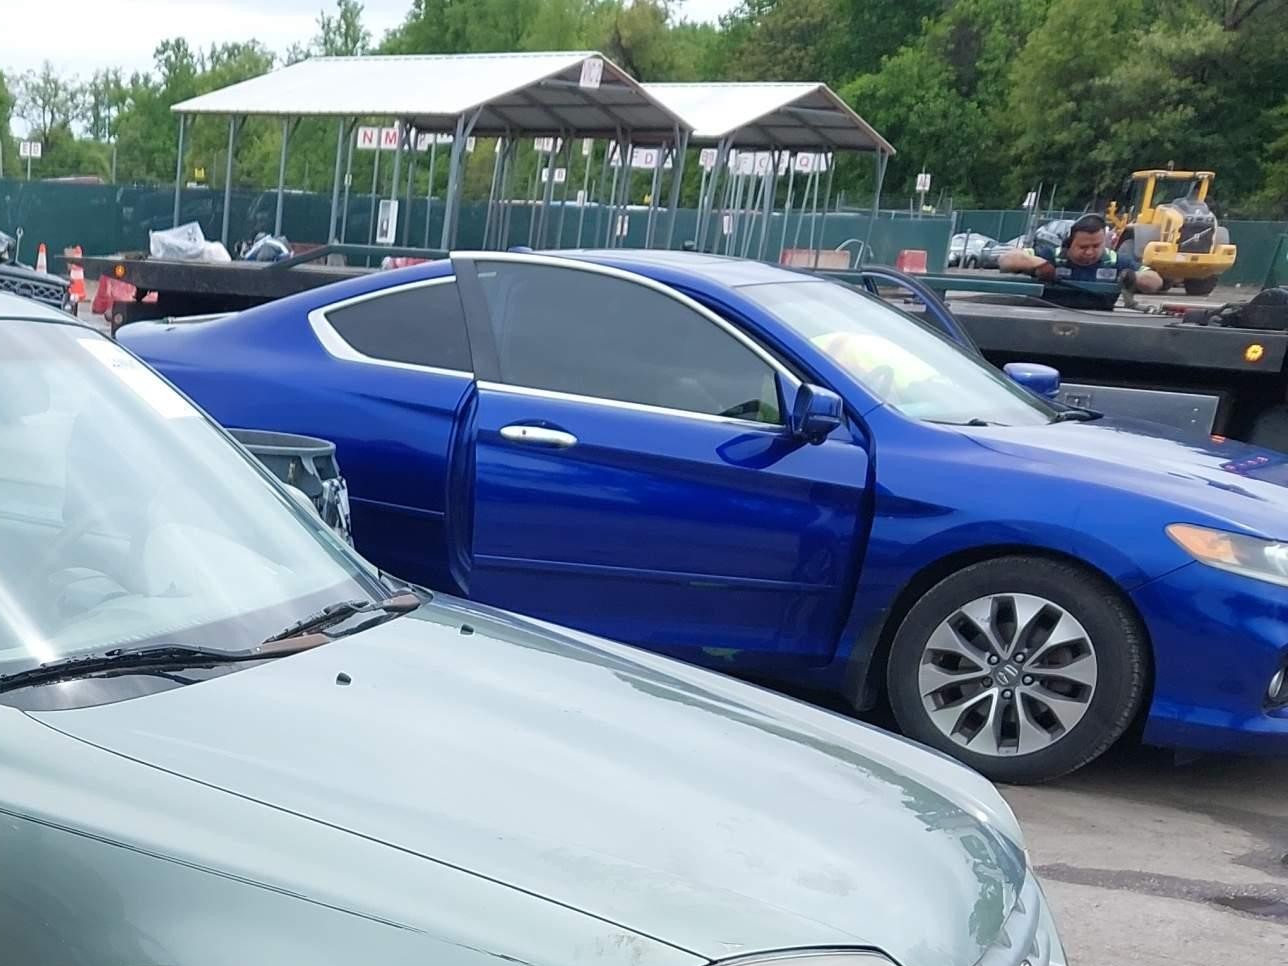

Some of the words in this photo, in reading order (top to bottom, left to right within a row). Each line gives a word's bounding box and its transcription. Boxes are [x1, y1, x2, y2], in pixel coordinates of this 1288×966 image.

[362, 130, 374, 144] N
[383, 130, 397, 145] M
[644, 149, 653, 165] D
